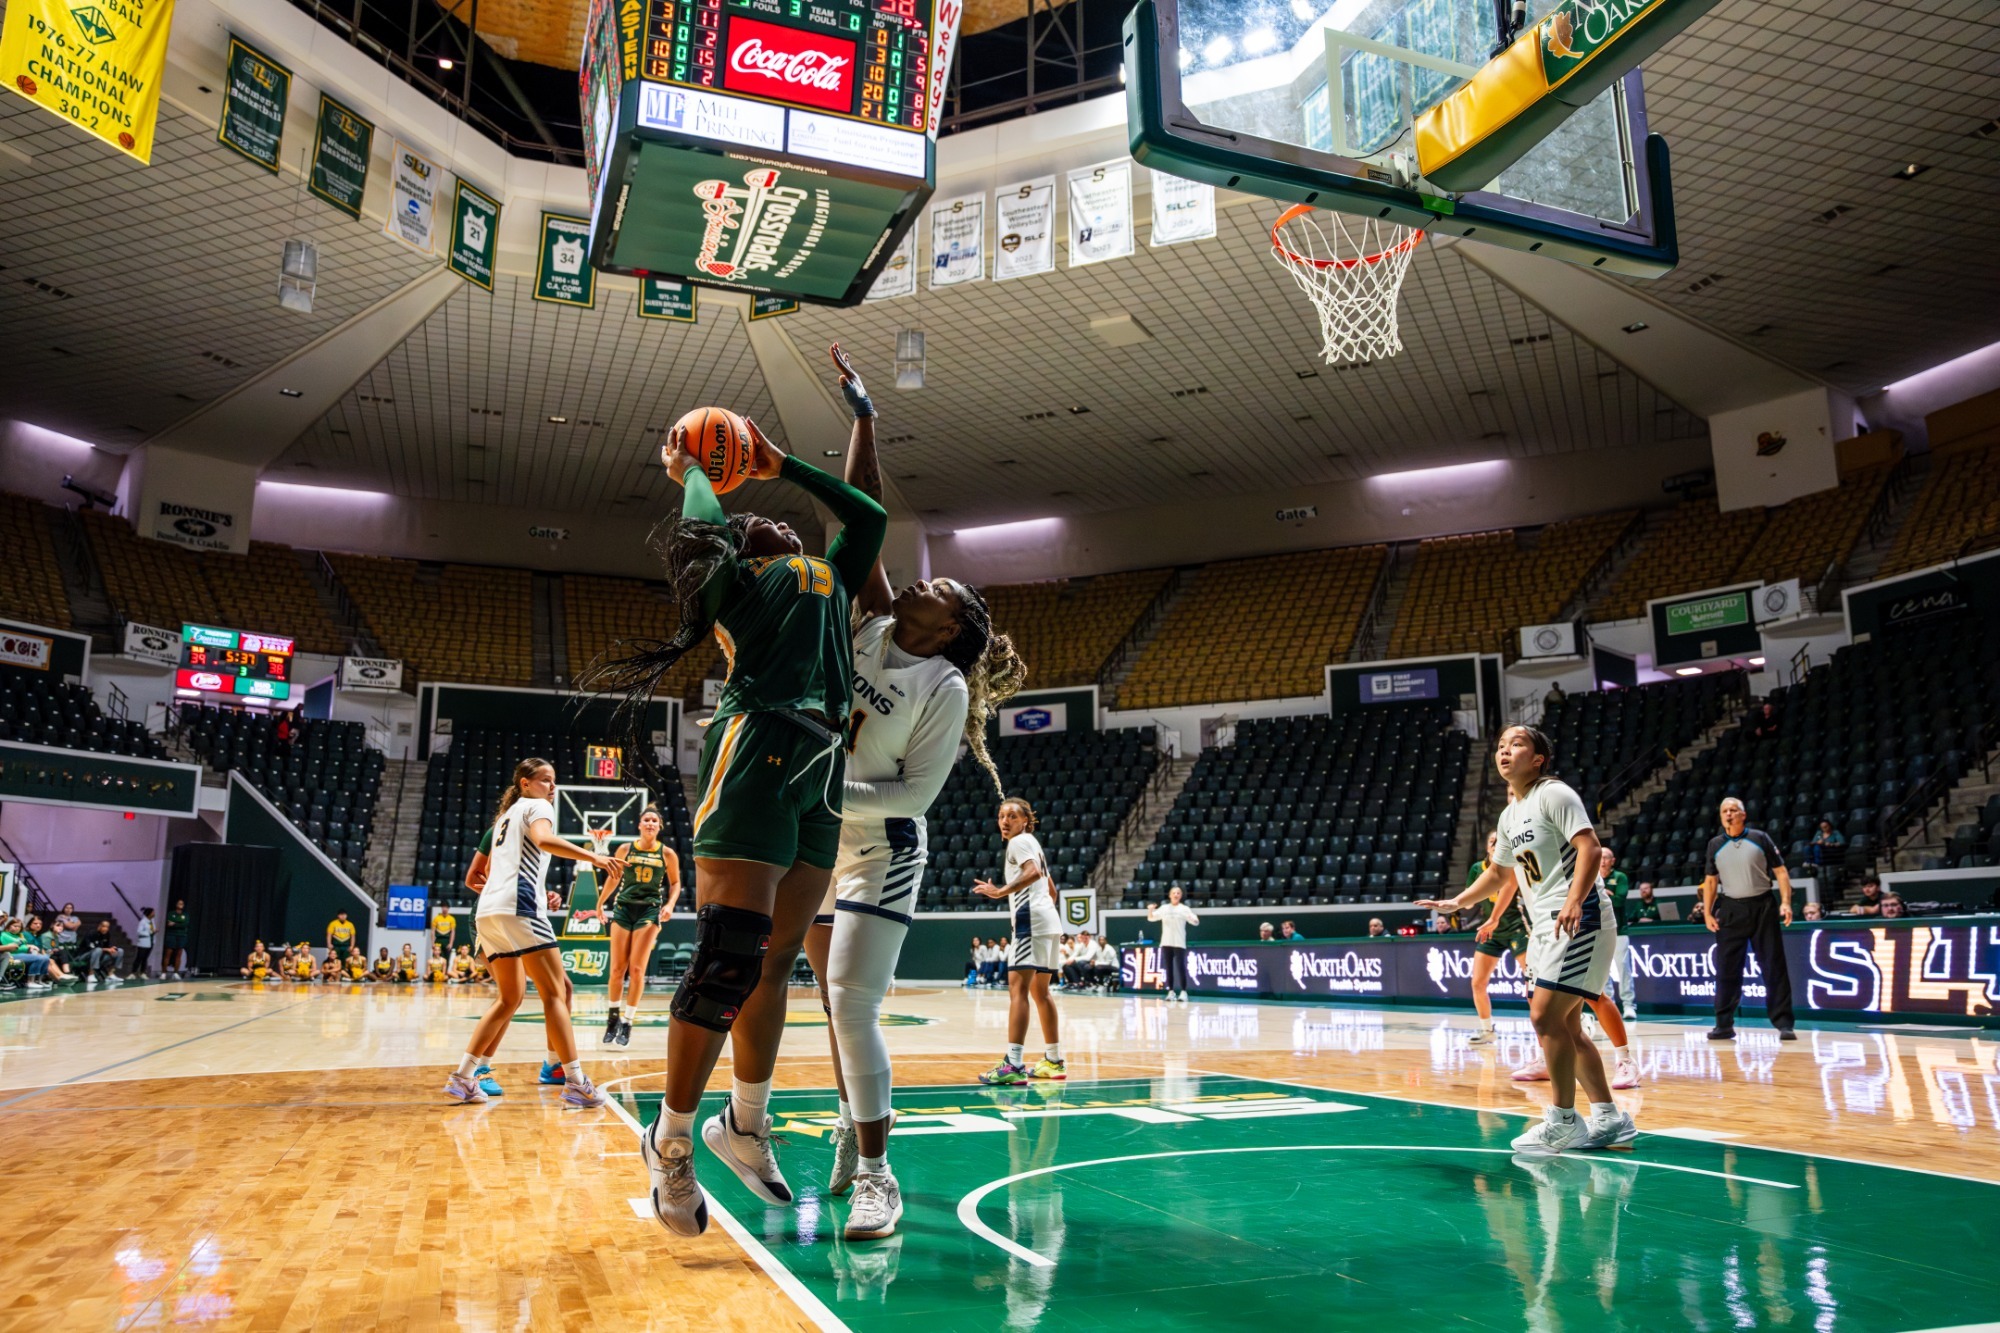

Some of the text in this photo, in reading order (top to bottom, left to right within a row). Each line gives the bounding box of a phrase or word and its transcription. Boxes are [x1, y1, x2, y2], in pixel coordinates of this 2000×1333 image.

[101, 0, 143, 28] BALL
[664, 2, 674, 19] 3
[752, 1, 781, 14] FOULS
[811, 6, 834, 18] TEAM
[702, 11, 718, 28] 11
[809, 12, 837, 27] FOULS
[873, 20, 886, 28] NO
[875, 12, 903, 24] BONUS
[1583, 0, 1651, 44] OAK
[661, 23, 672, 39] 4
[706, 31, 717, 47] 2
[877, 29, 888, 45] 0
[912, 28, 928, 38] PTS
[620, 0, 642, 81] ASTERN
[28, 14, 144, 93] 1976-77 AIAW
[654, 40, 670, 58] 10
[876, 48, 886, 64] 3
[699, 50, 714, 66] 15
[731, 38, 849, 92] Coca-Cola
[917, 57, 926, 72] 5
[41, 44, 126, 105] NATIONAL
[652, 60, 668, 77] 13
[674, 64, 685, 80] 2
[870, 66, 885, 82] 10
[702, 70, 713, 86] 2
[916, 75, 926, 91] 9
[28, 60, 132, 128] CHAMPIONS
[862, 84, 884, 102] 20
[914, 93, 924, 109] 8
[59, 98, 99, 130] 30-2
[861, 102, 882, 120] 21
[887, 108, 897, 122] 2
[912, 112, 922, 128] 6
[696, 115, 776, 145] PRINTING
[1092, 168, 1105, 182] S
[1019, 185, 1032, 200] S
[1166, 200, 1198, 212] SLC
[470, 226, 481, 241] 21
[743, 186, 808, 272] Crossroads
[774, 188, 830, 278] TANGIPAHOA PARISH
[1024, 232, 1045, 242] SLC
[560, 253, 575, 264] 34
[708, 423, 727, 482] Wilson
[737, 432, 750, 476] NCAA
[160, 502, 233, 528] RONNIE'S
[1276, 506, 1318, 521] Gate 1
[528, 526, 570, 540] Gate 2
[786, 557, 834, 598] 13
[1671, 598, 1738, 618] COURTYARD
[1890, 592, 1953, 619] cena
[133, 624, 179, 644] RONNIE'S
[190, 652, 206, 665] 39
[226, 650, 256, 665] 5:37
[240, 666, 248, 676] 3
[269, 662, 284, 675] 38
[852, 670, 894, 716] ONS
[600, 760, 616, 778] 18
[496, 818, 510, 848] 3
[634, 866, 654, 883] 10
[389, 896, 425, 912] FGB
[1071, 902, 1085, 918] S
[561, 950, 609, 973] SLU
[1217, 976, 1258, 990] Health System
[1330, 979, 1382, 993] Health System
[1486, 980, 1512, 994] ealth
